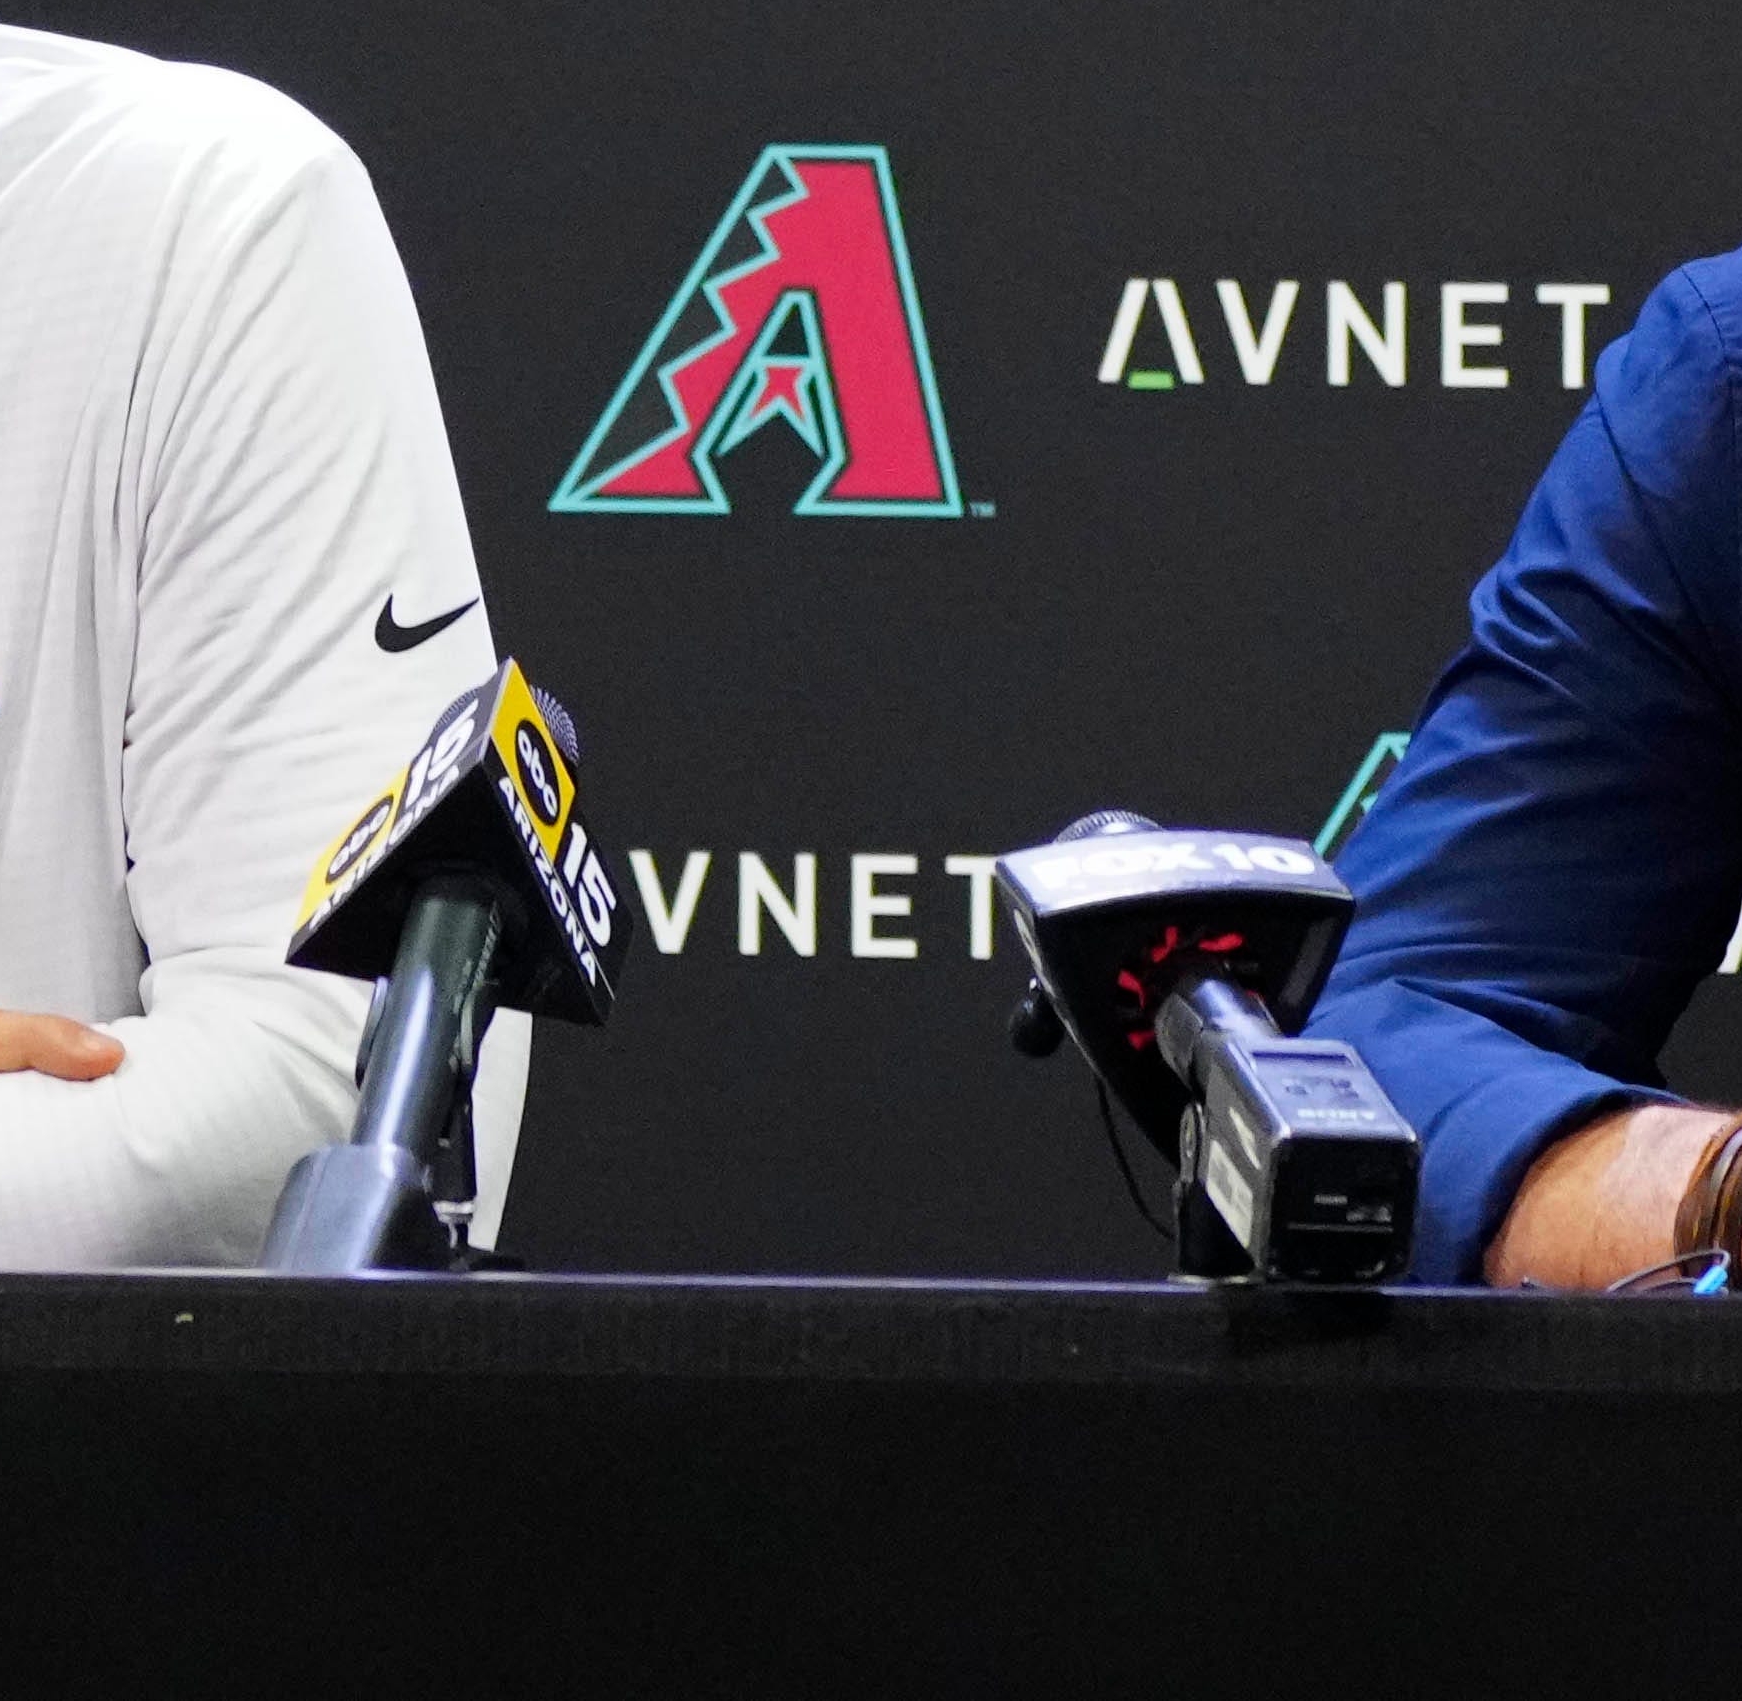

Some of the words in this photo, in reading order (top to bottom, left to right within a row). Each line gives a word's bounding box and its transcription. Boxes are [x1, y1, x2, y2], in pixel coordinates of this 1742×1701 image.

[1098, 278, 1610, 390] AVNET
[404, 698, 480, 807] 15
[518, 729, 558, 818] abc
[499, 776, 597, 987] ARIZONA
[562, 822, 618, 947] 15
[627, 849, 997, 961] VNET
[1031, 843, 1214, 889] FOX
[1214, 843, 1316, 876] 10
